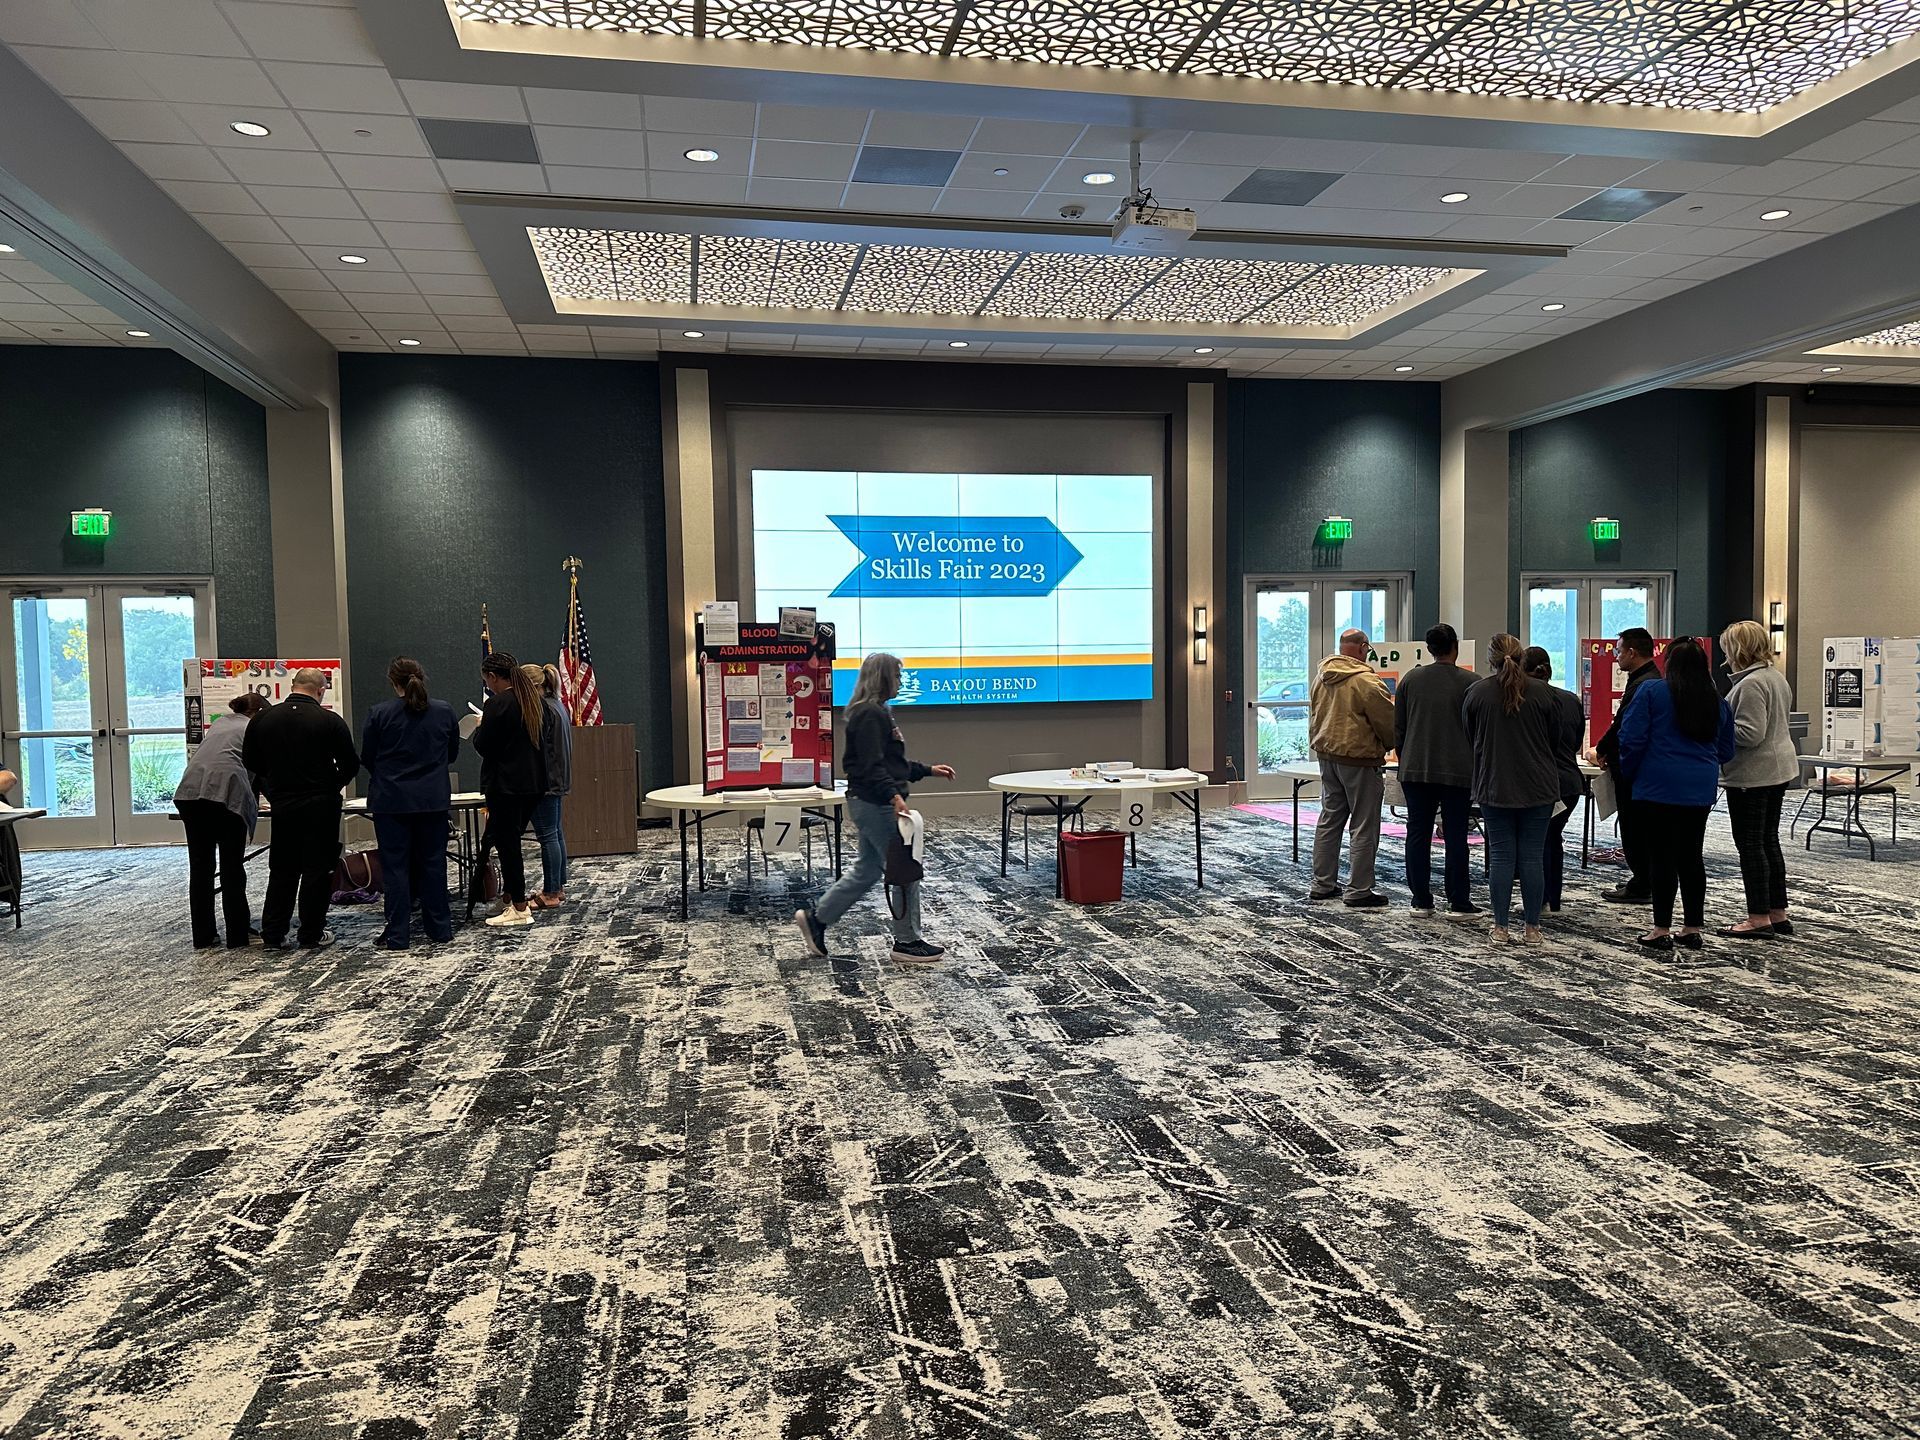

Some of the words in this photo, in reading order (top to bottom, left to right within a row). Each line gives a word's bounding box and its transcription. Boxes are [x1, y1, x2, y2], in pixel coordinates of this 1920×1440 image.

[1330, 521, 1348, 538] EXIT
[1598, 522, 1616, 538] EXIT
[892, 531, 997, 553] Welcome
[1002, 534, 1024, 553] to
[871, 558, 932, 580] Skills
[938, 558, 984, 580] Fair
[990, 563, 1045, 583] 2023
[741, 628, 778, 638] BLOOD
[719, 645, 808, 656] ADMINISTRATION
[200, 660, 288, 679] SEPSIS
[930, 679, 988, 692] BAYOU
[992, 677, 1037, 690] BEND
[1128, 803, 1144, 827] 8
[774, 821, 792, 847] 7
